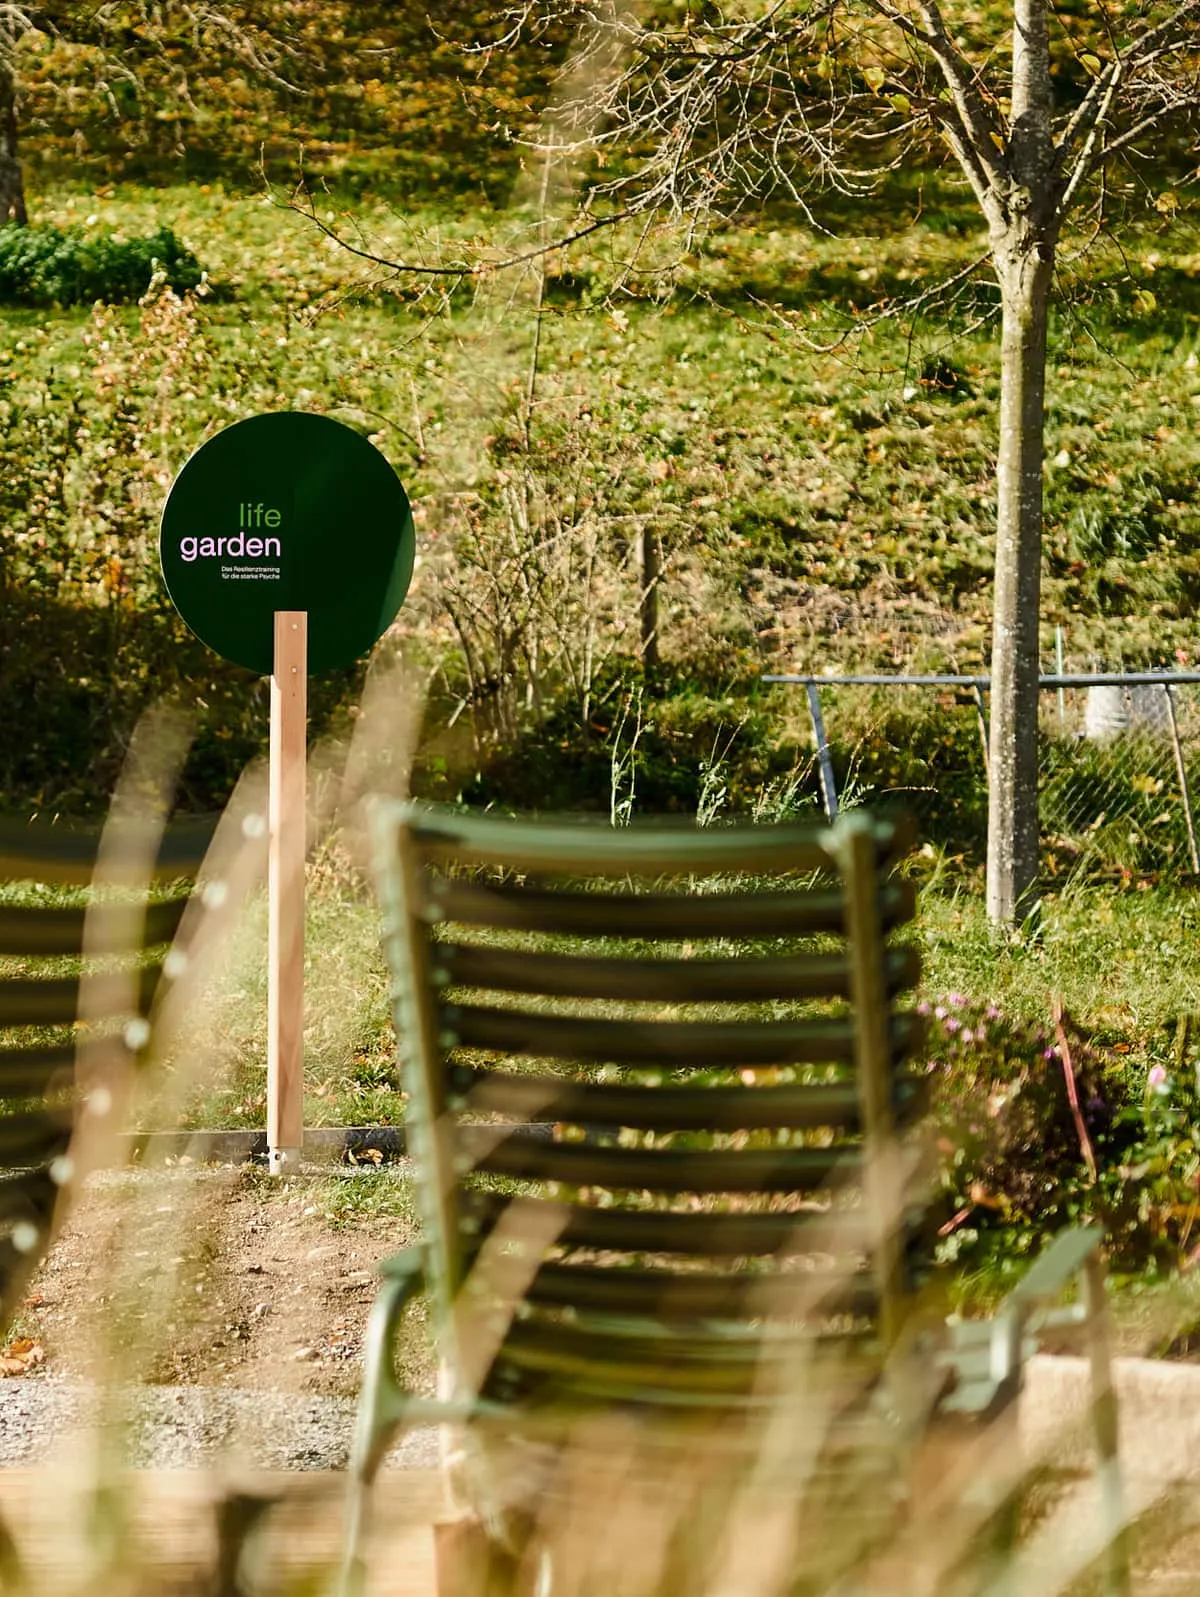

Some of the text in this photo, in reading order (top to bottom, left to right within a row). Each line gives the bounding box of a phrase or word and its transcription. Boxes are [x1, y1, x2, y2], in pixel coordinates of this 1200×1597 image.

[240, 503, 281, 527] life
[180, 531, 281, 561] garden
[259, 573, 280, 581] Psyche
